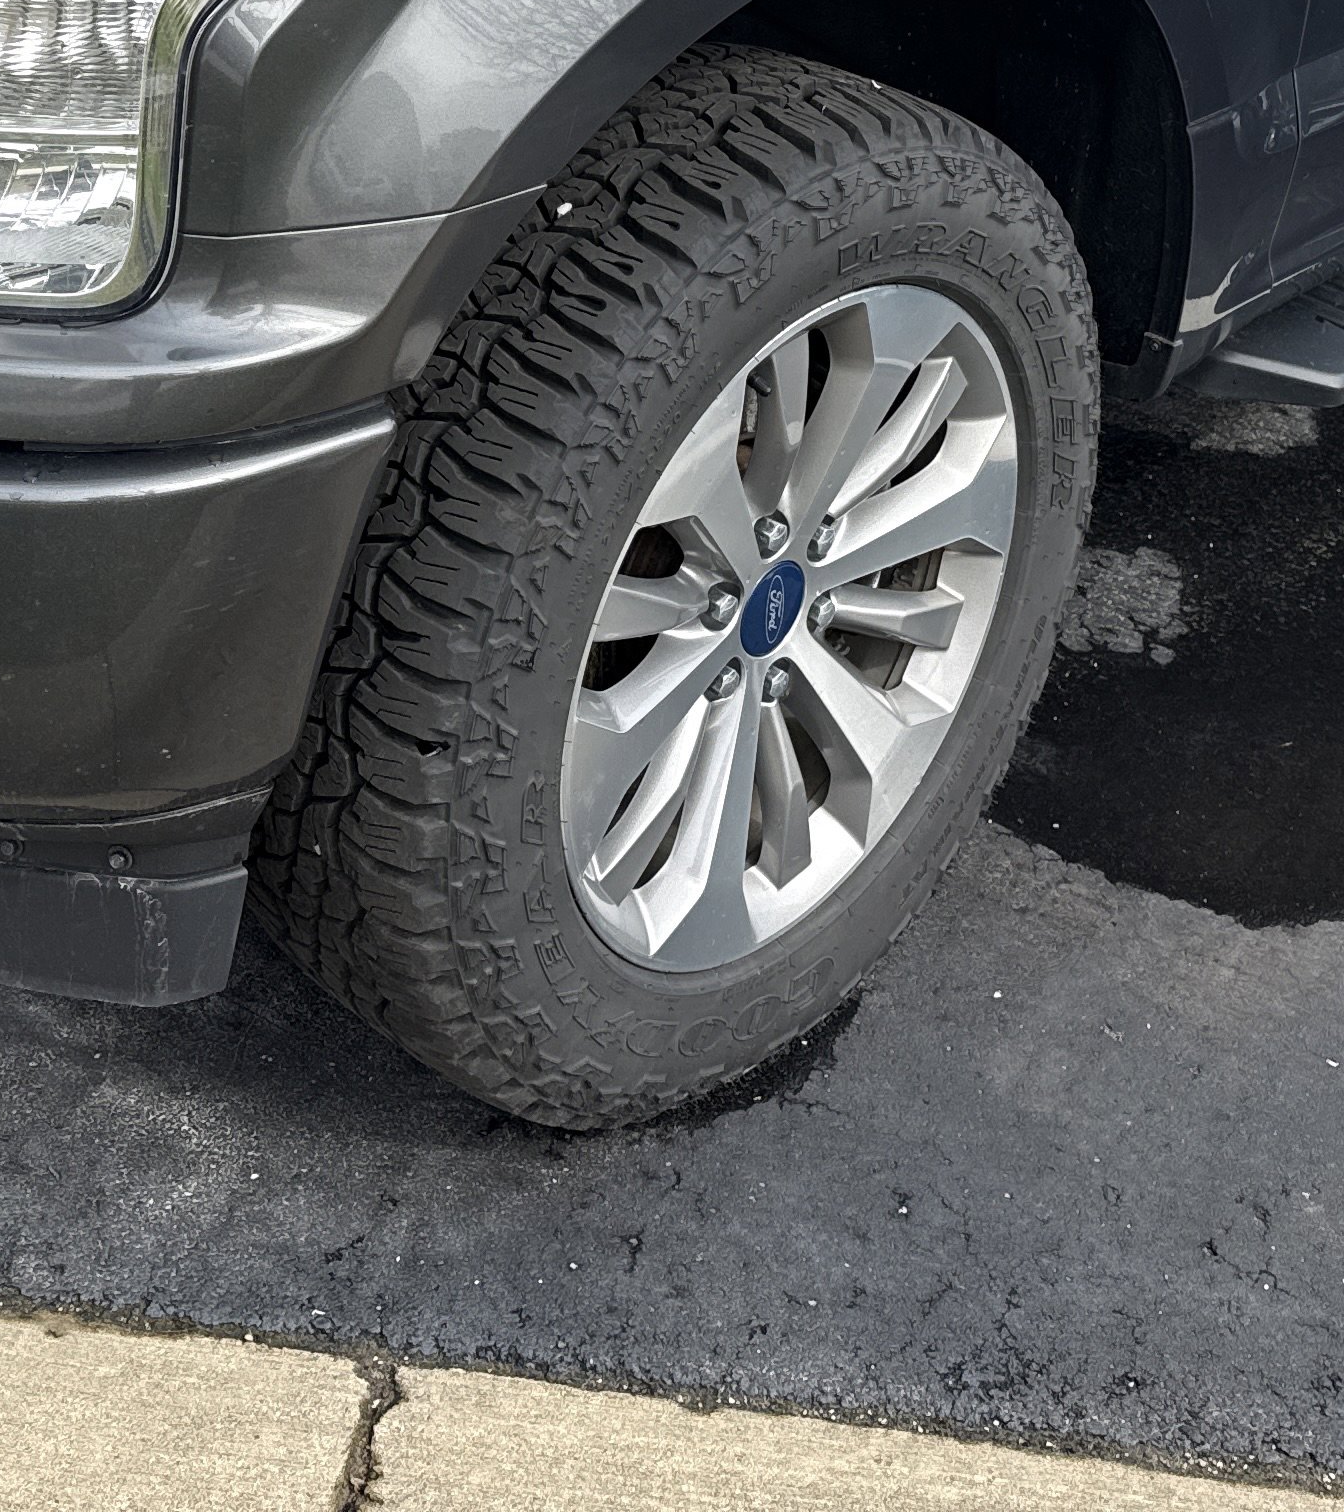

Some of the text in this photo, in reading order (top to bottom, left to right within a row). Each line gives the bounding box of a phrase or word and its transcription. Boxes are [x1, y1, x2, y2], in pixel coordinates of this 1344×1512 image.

[839, 221, 1077, 510] WRANGLER
[769, 589, 783, 631] Ford
[520, 769, 837, 1058] GOODYEAR
